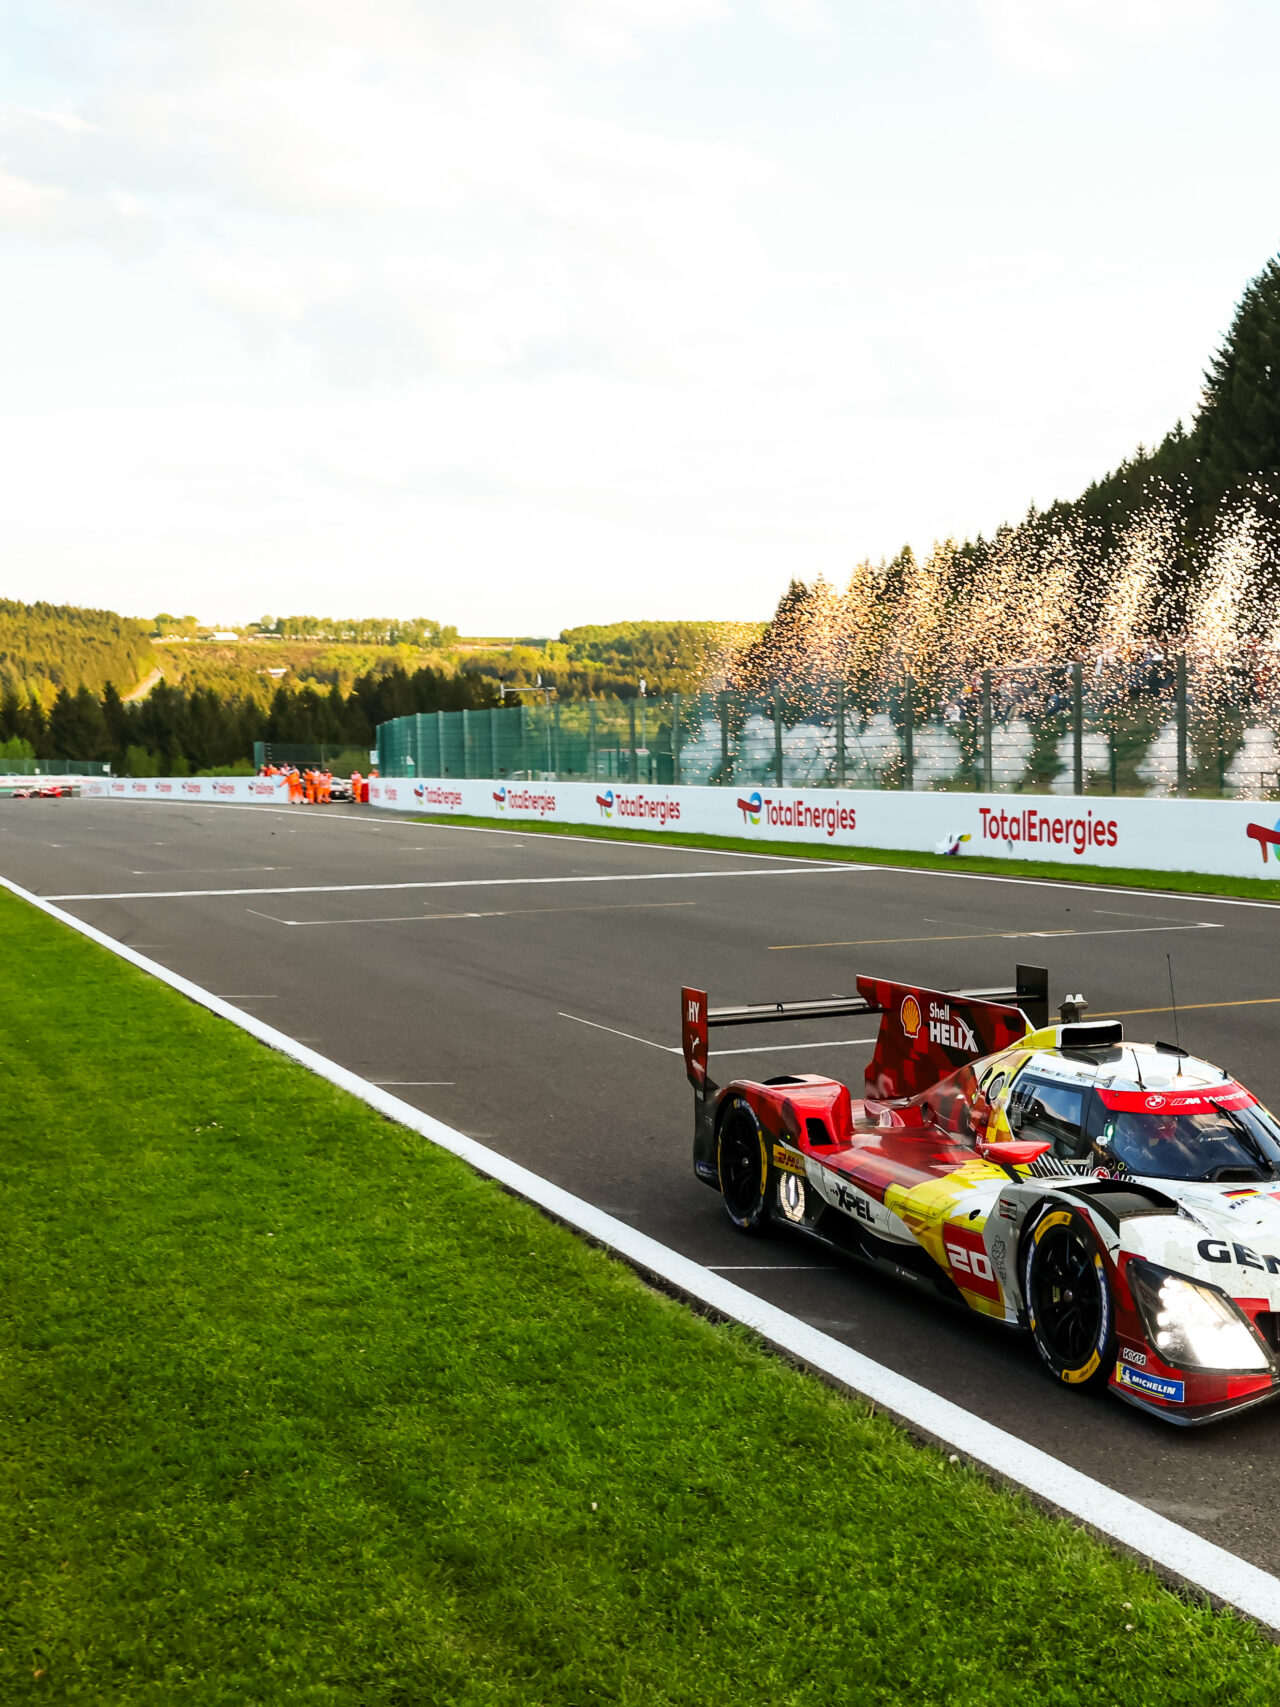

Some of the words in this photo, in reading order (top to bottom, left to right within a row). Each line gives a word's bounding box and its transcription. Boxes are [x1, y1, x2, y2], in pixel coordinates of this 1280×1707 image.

[508, 790, 555, 816] TotalEnergies
[616, 795, 680, 825] TotalEnergies
[764, 800, 856, 836] TotalEnergies
[979, 808, 1118, 854] TotalEnergies
[688, 1000, 700, 1023] HY
[929, 1002, 950, 1021] Shell
[929, 1016, 979, 1053] HELIX
[835, 1182, 876, 1224] XPEL
[946, 1243, 994, 1282] 20
[1131, 1375, 1176, 1395] MICHELIN
